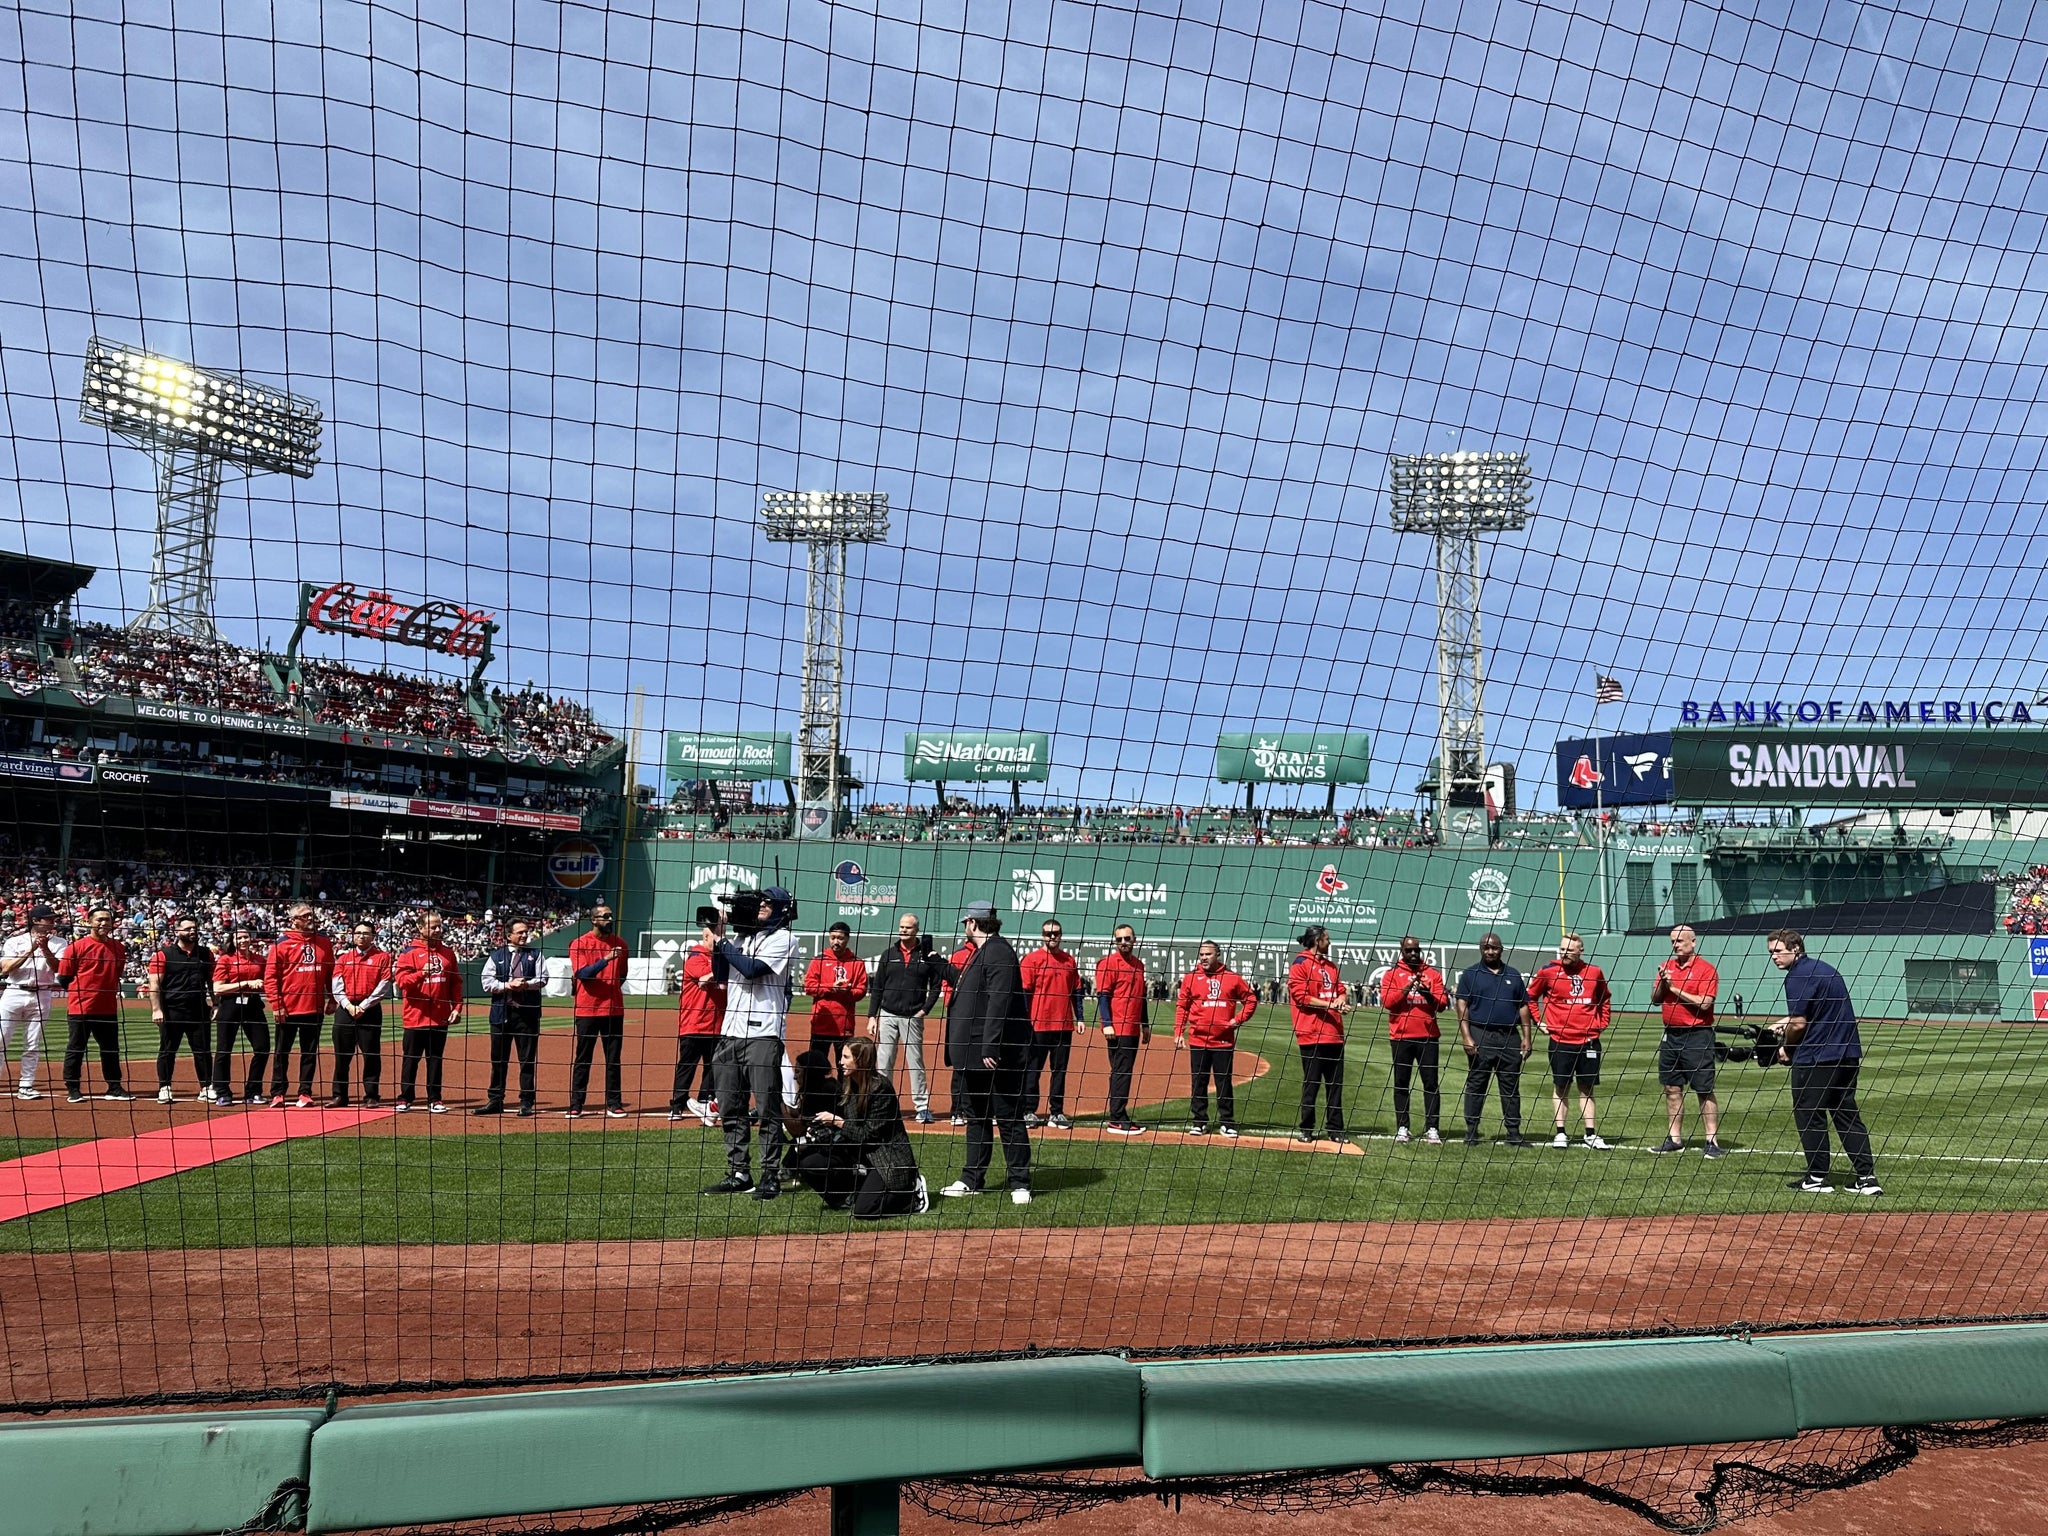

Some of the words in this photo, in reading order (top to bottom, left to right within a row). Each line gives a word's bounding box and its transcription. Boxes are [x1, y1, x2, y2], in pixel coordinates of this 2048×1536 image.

[137, 704, 190, 721] WELCOME
[194, 712, 207, 722] TO
[210, 715, 254, 729] OPENING
[257, 721, 279, 732] DAY
[1681, 701, 1783, 723] BANK
[1798, 701, 1843, 723] OF
[1856, 701, 2032, 723] AMERICA
[681, 744, 740, 761] Plymouth
[743, 744, 775, 759] Rock
[1254, 751, 1328, 767] DRAFT
[974, 763, 993, 773] Car
[996, 764, 1031, 773] Rental
[1264, 765, 1326, 778] KINGS
[1728, 743, 1917, 788] SANDOVAL
[102, 770, 150, 783] CROCHET.
[1629, 844, 1695, 858] ABIOMED
[549, 855, 601, 873] Gulf
[689, 865, 717, 891] JIM
[718, 860, 759, 889] BEAM
[841, 885, 866, 895] RED
[870, 885, 897, 895] SOX
[1059, 881, 1167, 903] BETMGM
[1314, 896, 1330, 904] RED
[1333, 896, 1351, 904] SOX
[838, 906, 869, 916] BIDMC
[1288, 903, 1377, 916] FOUNDATION
[1219, 944, 1253, 952] ATIONAL
